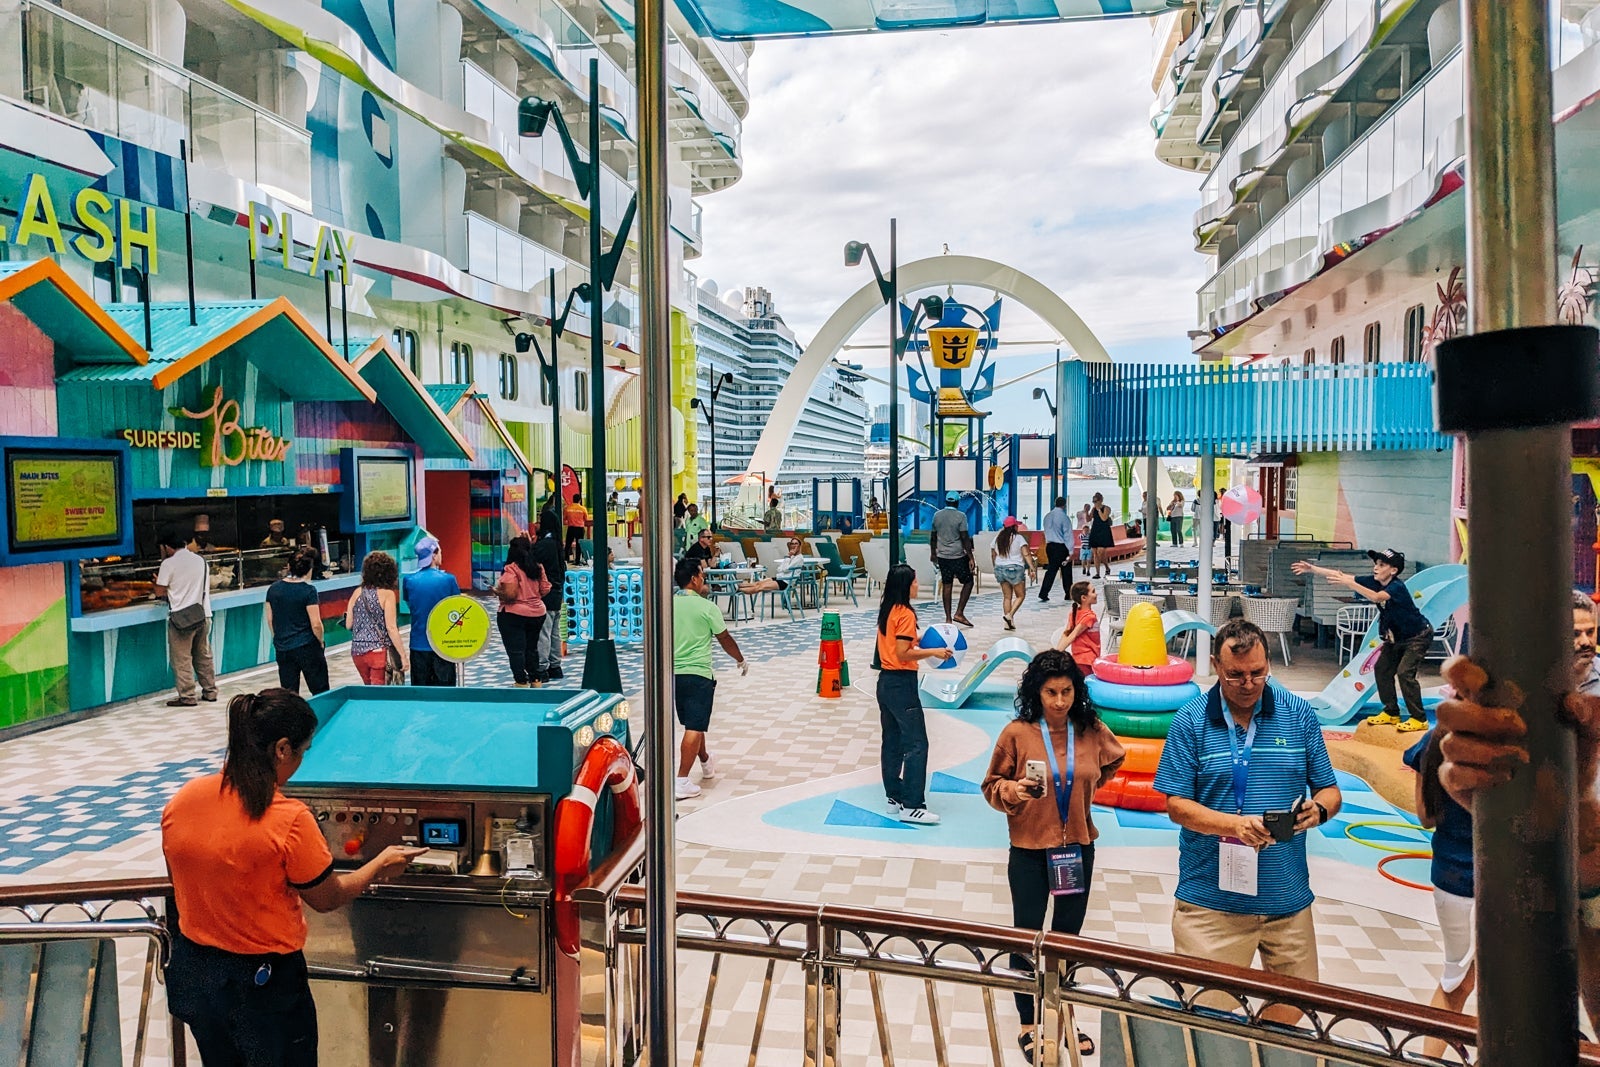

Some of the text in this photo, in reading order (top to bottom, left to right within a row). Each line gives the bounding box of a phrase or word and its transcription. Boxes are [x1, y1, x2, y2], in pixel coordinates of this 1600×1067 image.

[0, 173, 356, 286] ASH PLAY
[123, 386, 292, 467] SURFSIDE Bites
